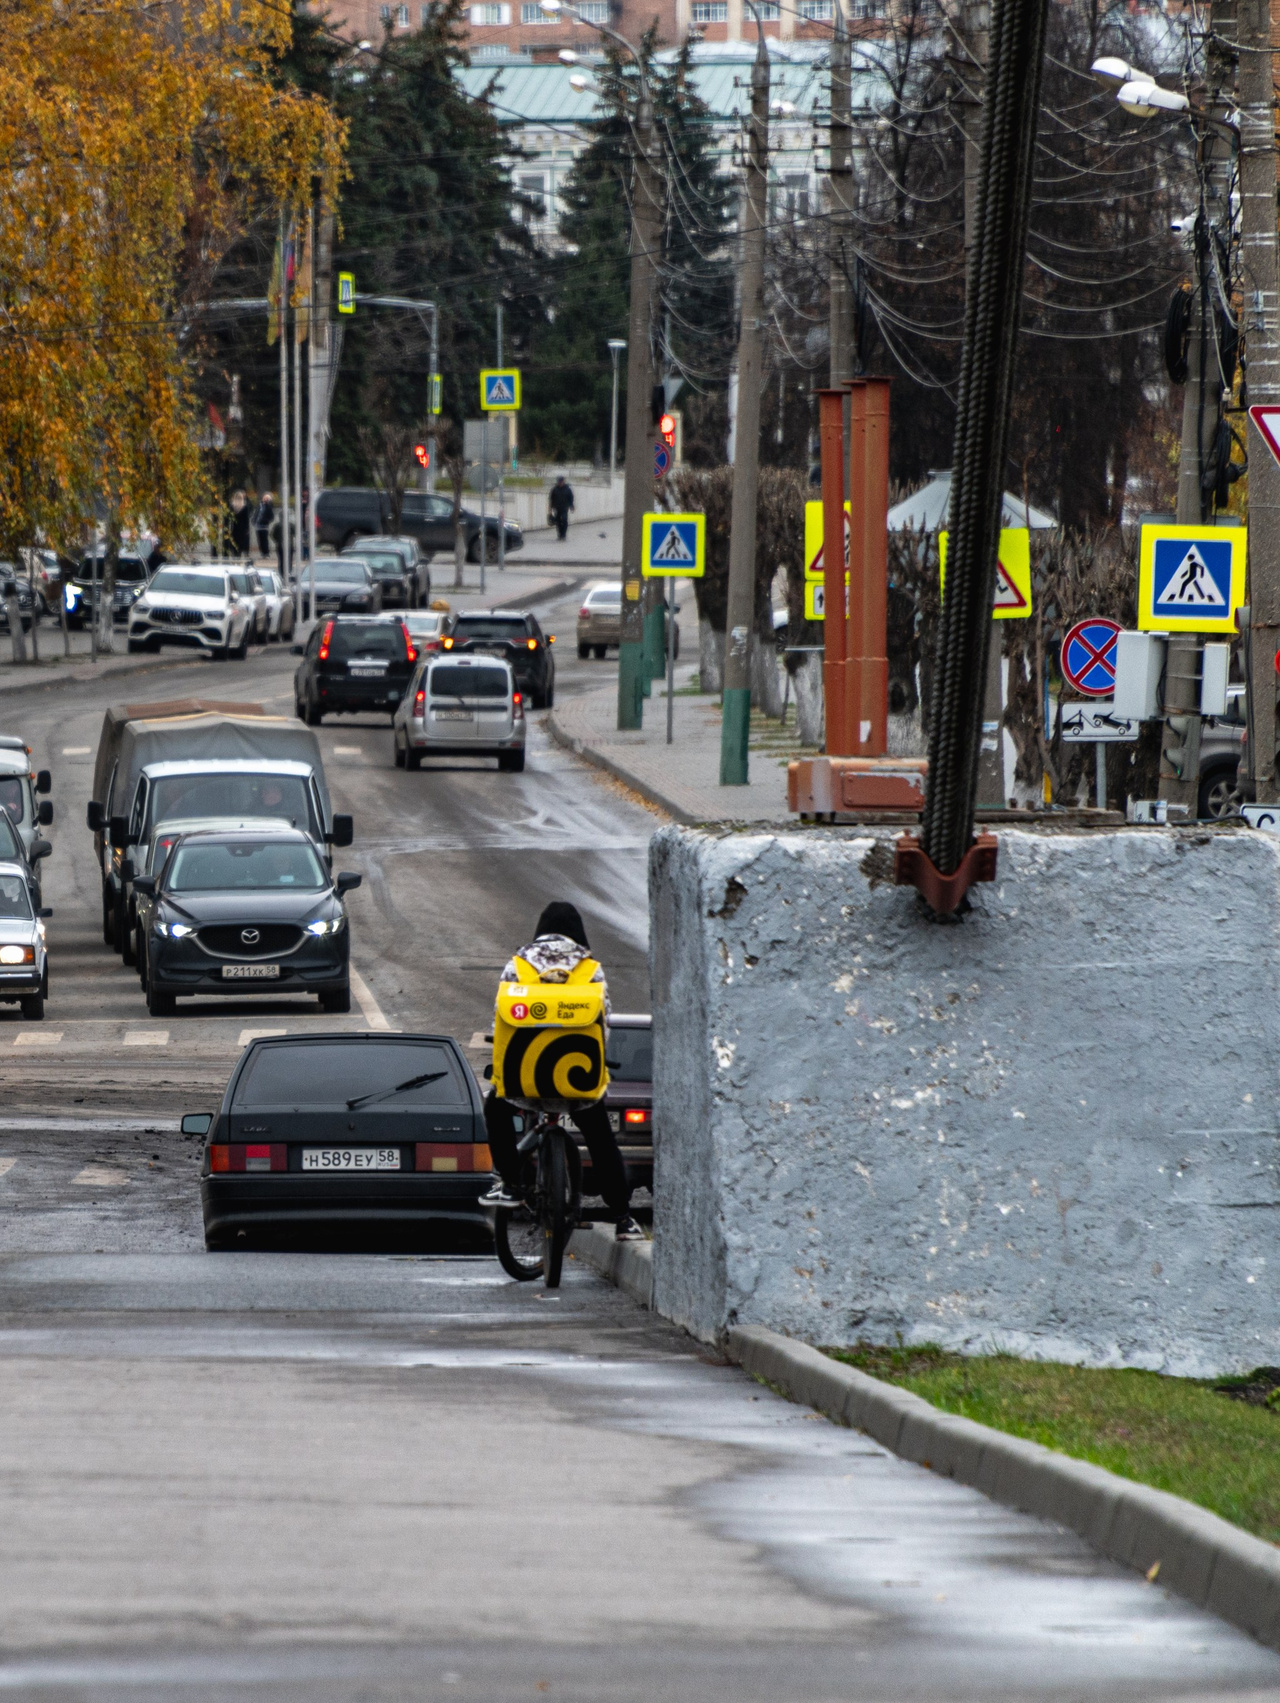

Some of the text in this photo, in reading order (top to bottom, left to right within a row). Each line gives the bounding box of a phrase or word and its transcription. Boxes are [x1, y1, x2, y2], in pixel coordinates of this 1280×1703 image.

[557, 1001, 590, 1010] Яндекс
[557, 1010, 574, 1019] Еда
[379, 1150, 395, 1162] 58
